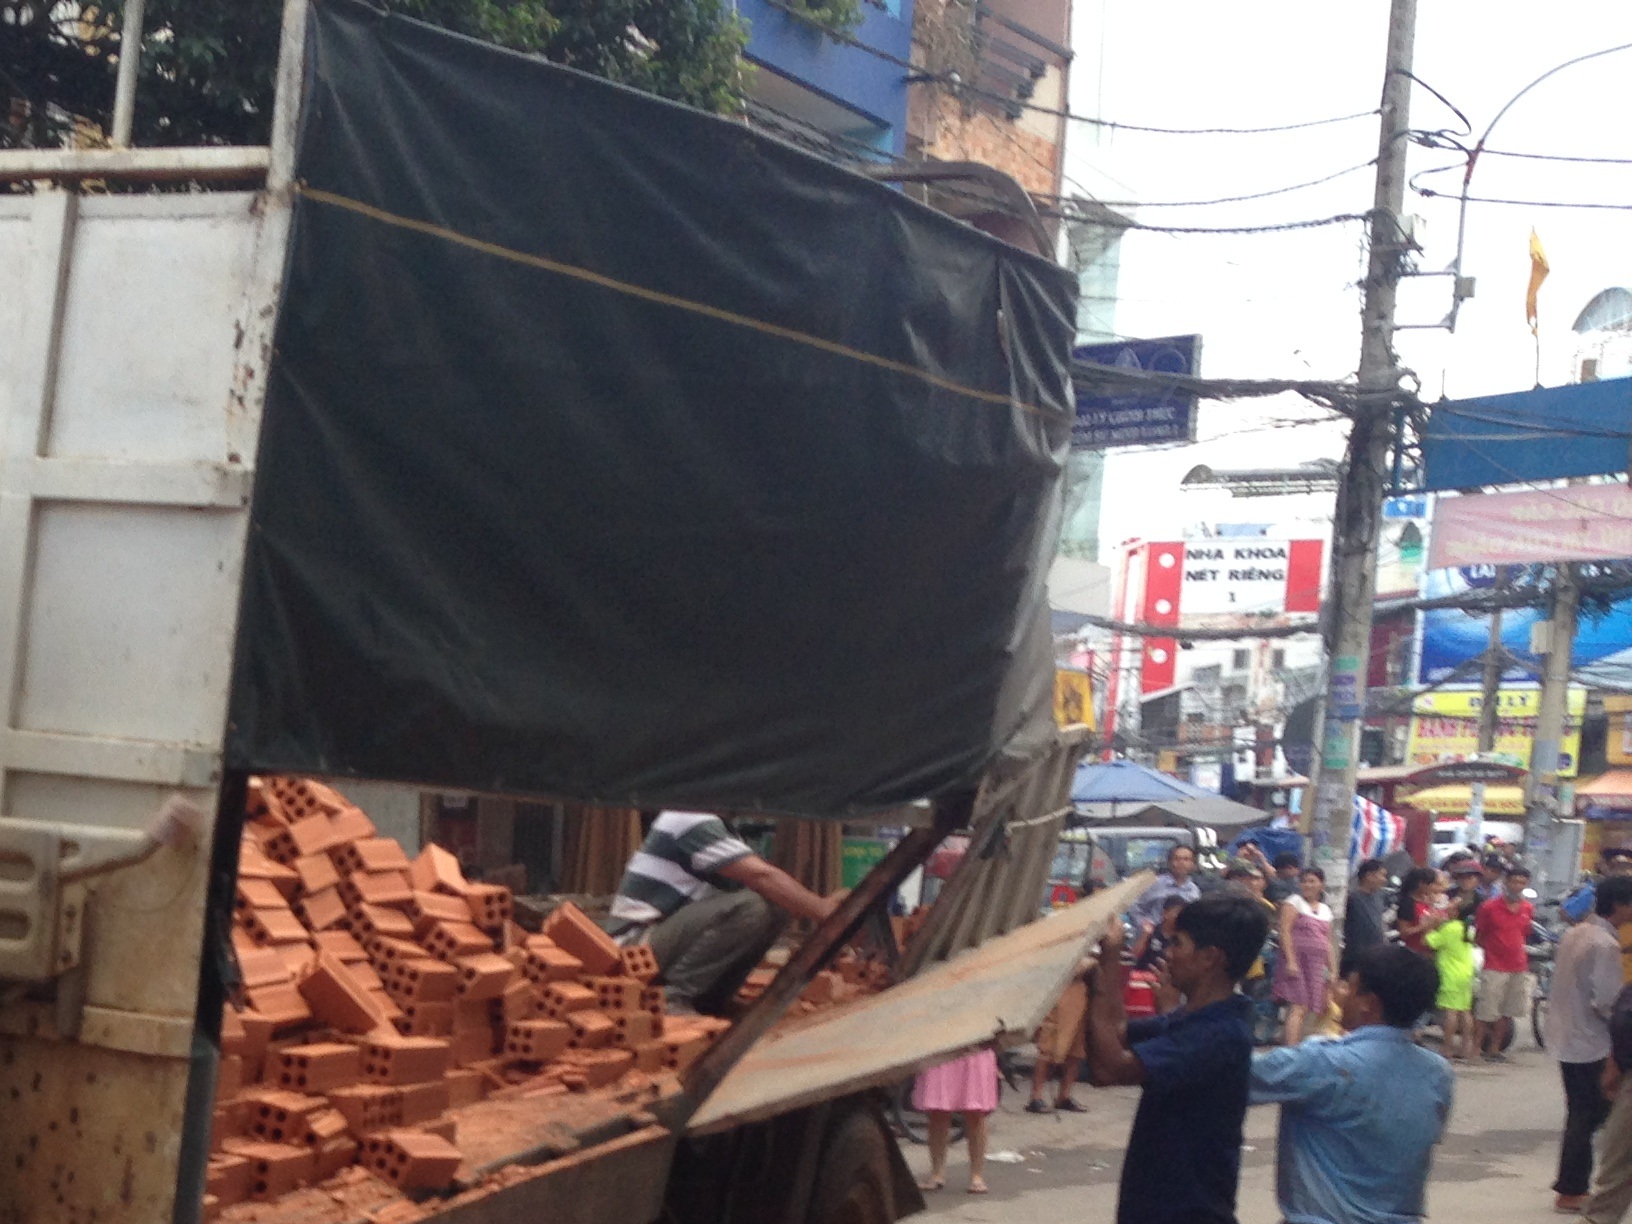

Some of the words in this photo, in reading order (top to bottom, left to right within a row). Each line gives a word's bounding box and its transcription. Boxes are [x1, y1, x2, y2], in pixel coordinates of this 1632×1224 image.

[1185, 547, 1225, 560] NHA
[1233, 547, 1286, 560] KHOA
[1228, 566, 1285, 581] RIÊNG
